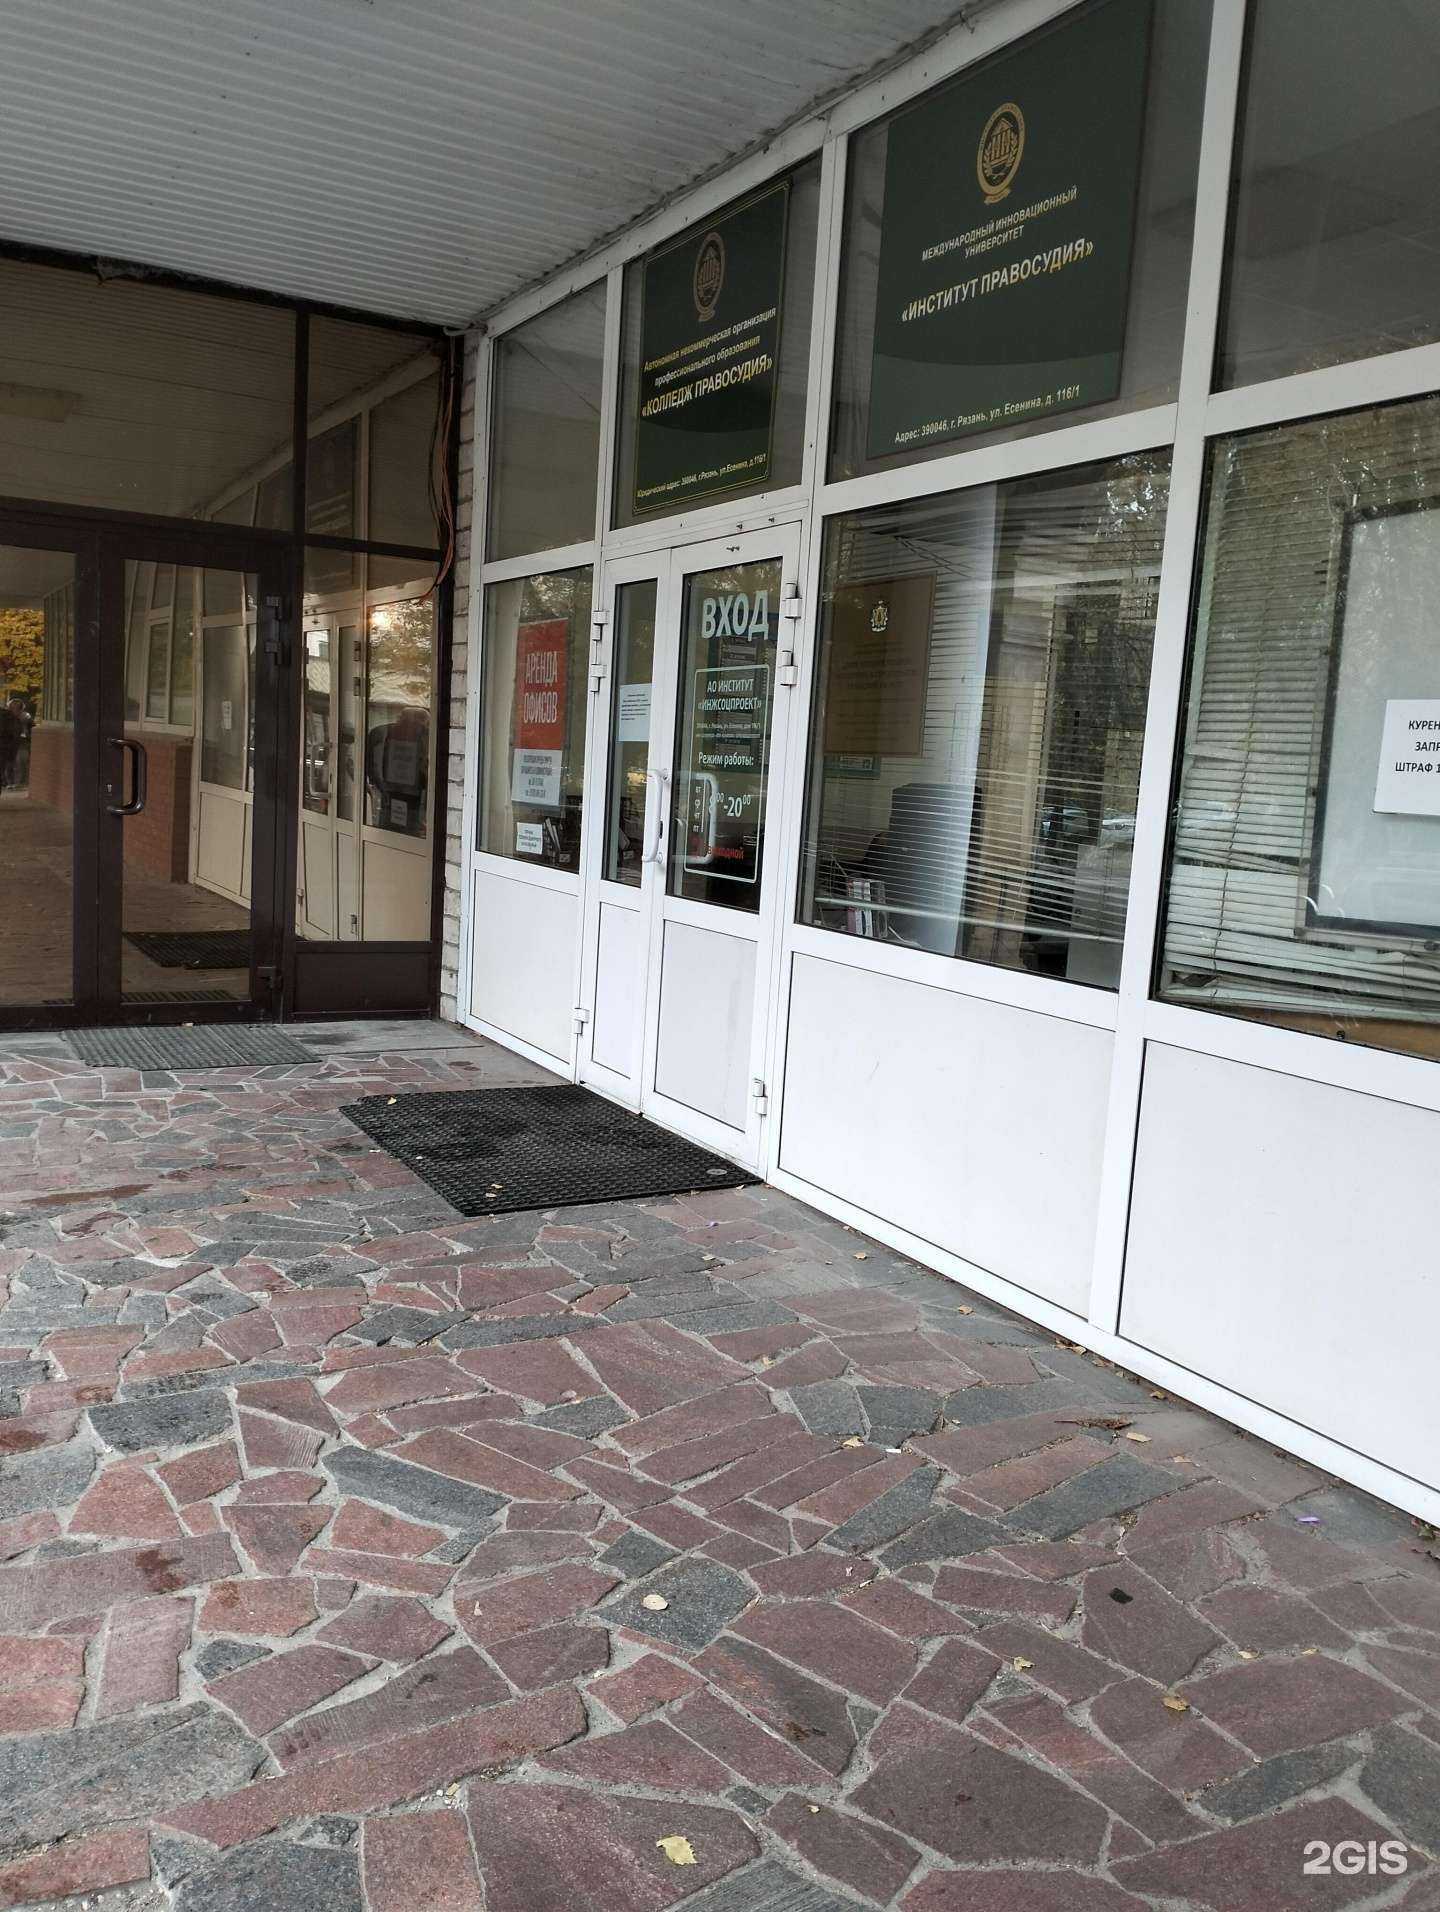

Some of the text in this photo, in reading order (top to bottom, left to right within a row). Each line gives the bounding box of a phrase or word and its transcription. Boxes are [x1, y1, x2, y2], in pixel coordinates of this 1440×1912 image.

[921, 184, 1078, 261] МЕЖДУНАРОДНЫЙ ИННОВАЦИОННЫЙ
[965, 224, 1025, 259] УНИВЕРСИТЕТ
[902, 238, 1095, 322] «ИНСТИТУТ ПРАВОСУДИЯ»
[643, 350, 681, 373] Автономная
[732, 307, 777, 335] организация
[654, 335, 761, 387] профессионального образования
[641, 354, 773, 417] «КОЛЛЕДЖ ПРАВОСУДИЯ»
[894, 430, 921, 444] Адрес:
[921, 419, 951, 437] 390046,
[957, 413, 988, 428] Рязань,
[1004, 397, 1044, 415] Есенина,
[1056, 384, 1081, 402] 116/1
[702, 589, 769, 642] ВХОД
[526, 650, 558, 687] АРЕНДА
[707, 678, 755, 693] АО ИНСТИТУТ
[523, 691, 558, 724] ОФИСОВ
[698, 751, 754, 768] Режим работы:
[1395, 762, 1433, 773] ШТРАФ
